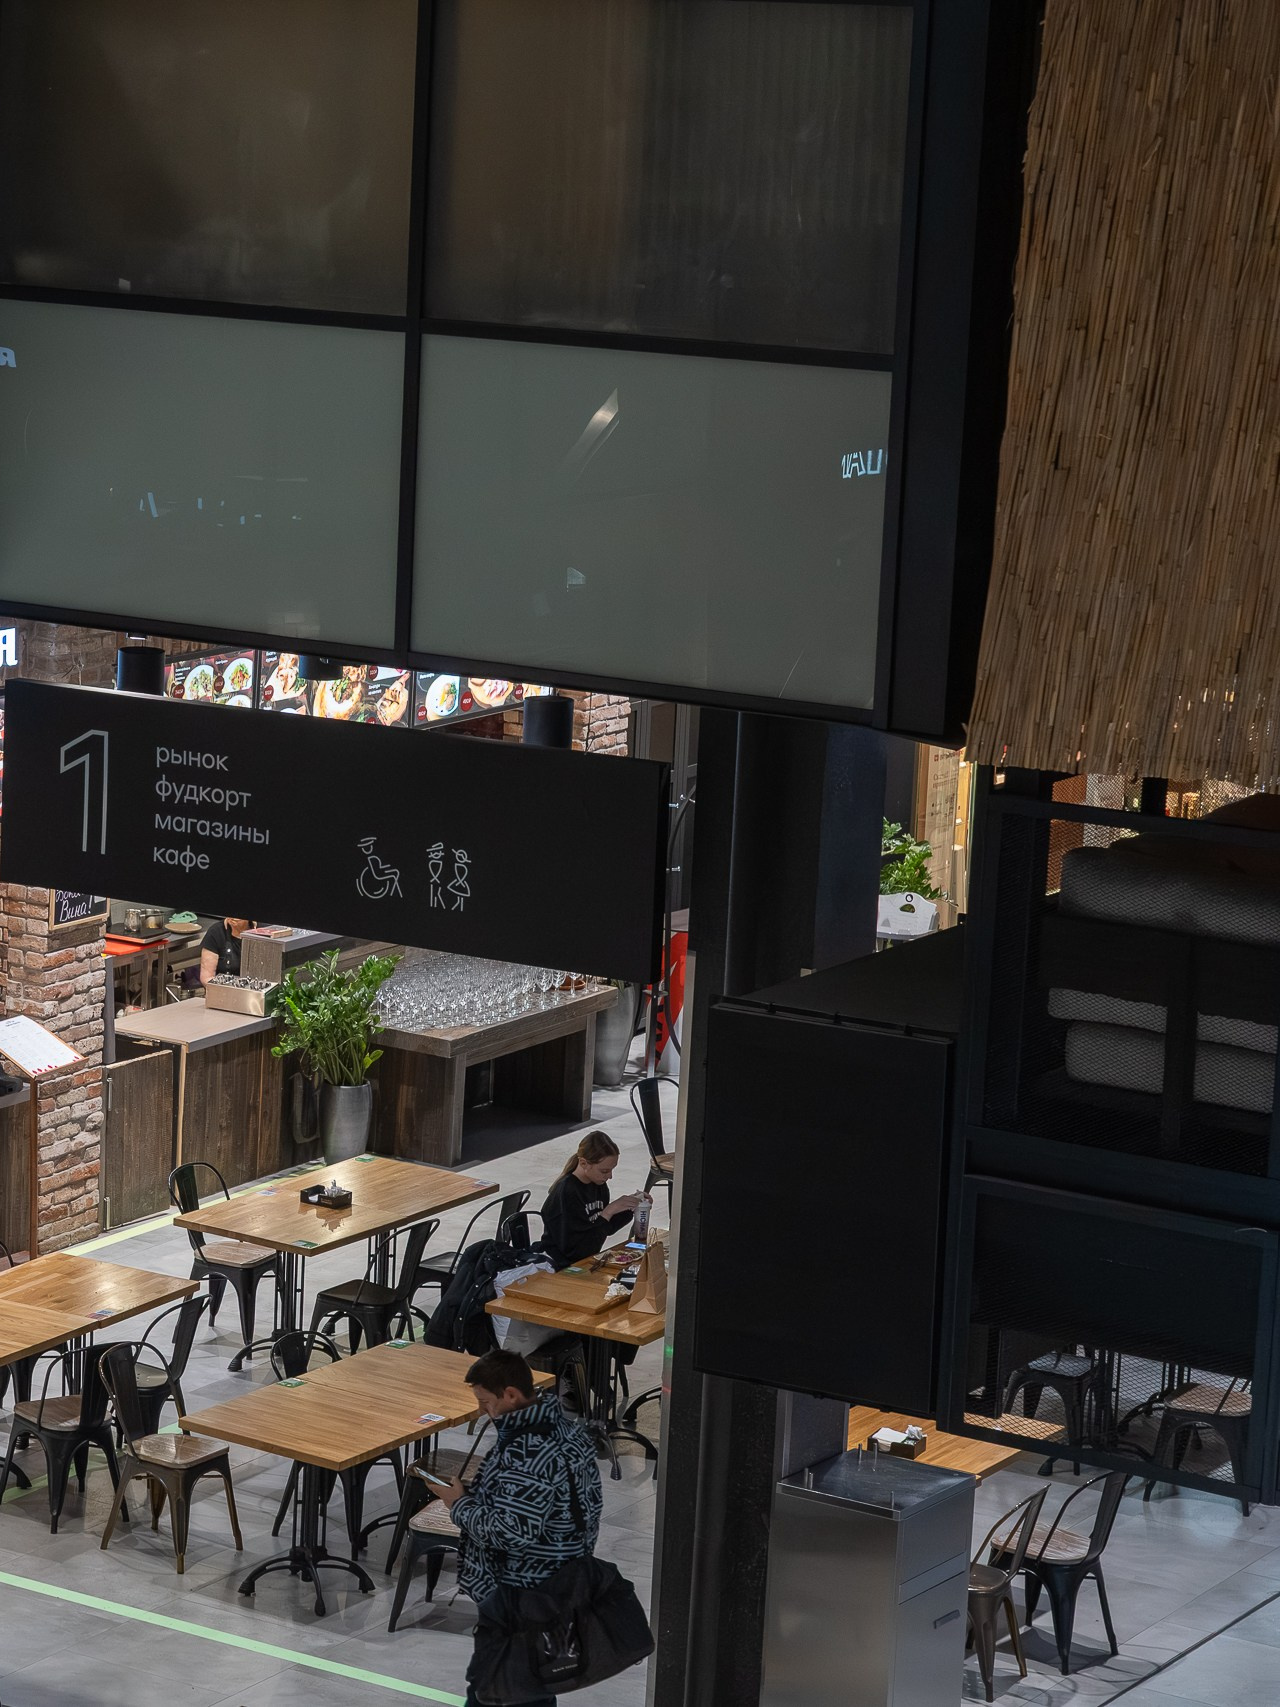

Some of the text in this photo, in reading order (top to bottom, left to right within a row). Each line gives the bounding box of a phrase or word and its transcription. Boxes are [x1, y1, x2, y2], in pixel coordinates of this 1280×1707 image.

[156, 746, 229, 772] рынок
[59, 729, 109, 855] 1
[155, 773, 252, 812] фудкорт
[154, 813, 270, 845] магазины
[153, 845, 210, 873] кафе
